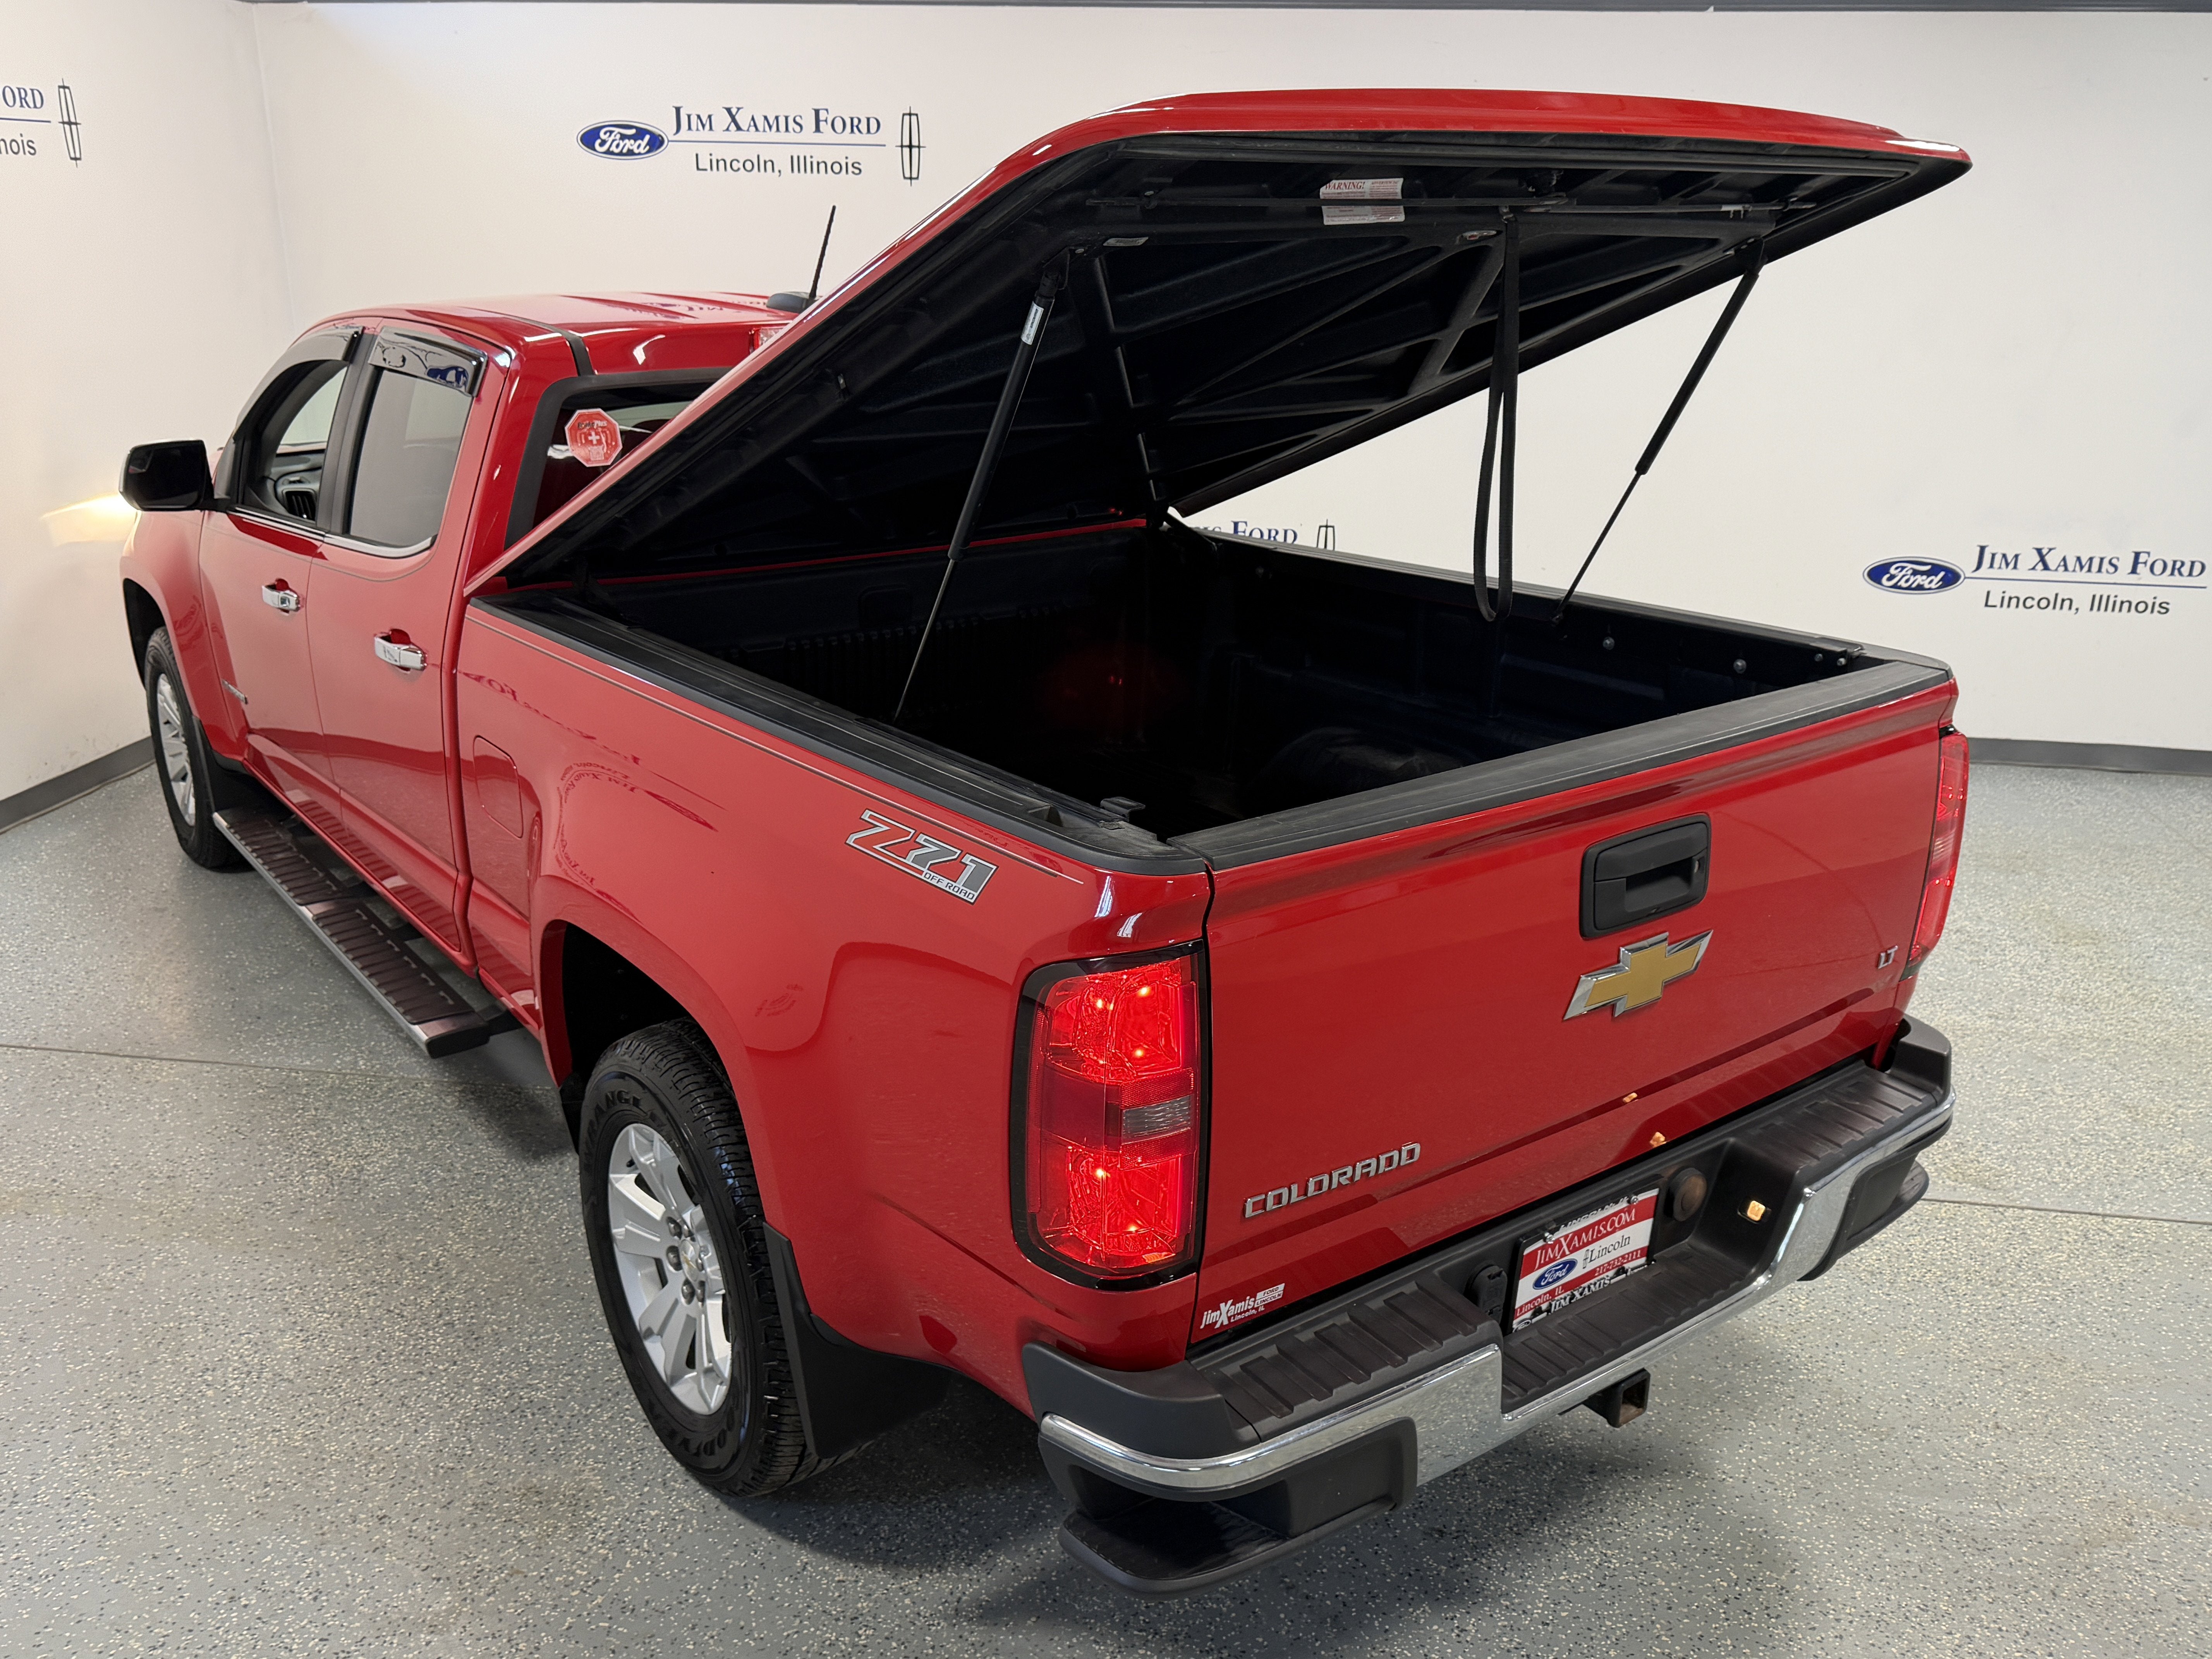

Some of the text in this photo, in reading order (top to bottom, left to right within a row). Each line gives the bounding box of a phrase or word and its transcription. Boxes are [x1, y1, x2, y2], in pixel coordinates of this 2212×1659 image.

[0, 85, 44, 109] ORD
[672, 105, 881, 136] JIM XAMIS FORD
[0, 133, 36, 156] nois
[594, 128, 650, 155] Ford
[696, 153, 862, 177] Lincoln, Illinois
[1324, 182, 1365, 190] WARNING!
[1972, 545, 2207, 577] JIM XAMIS FORD
[1881, 562, 1945, 590] Ford
[1984, 591, 2171, 615] Lincoln, Illinois
[845, 808, 999, 898] Z71
[924, 872, 975, 900] OFF ROAD
[1877, 945, 1898, 969] LT
[1244, 1142, 1420, 1218] COLORADO
[1588, 1236, 1630, 1264] Lincoln
[1541, 1264, 1567, 1285] Ford
[1256, 1292, 1282, 1305] LINCOLN
[1263, 1287, 1279, 1296] FORD
[1550, 1277, 1611, 1313] JIM XAMIS
[1555, 1286, 1564, 1296] IL
